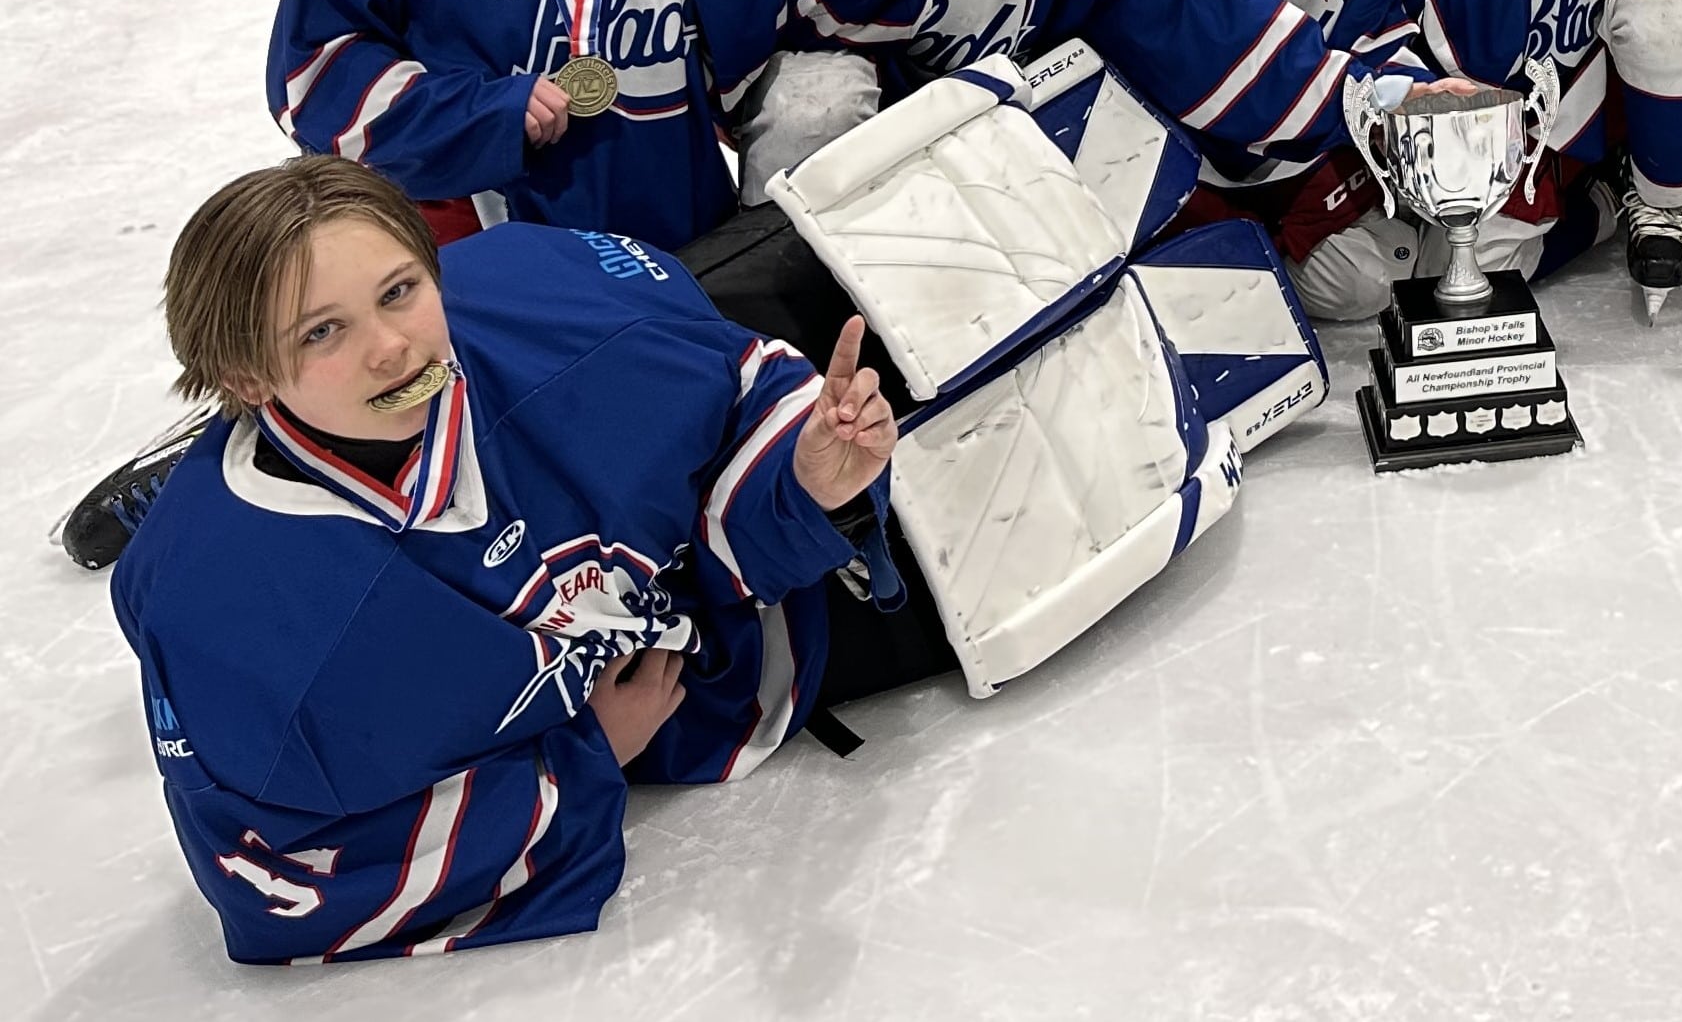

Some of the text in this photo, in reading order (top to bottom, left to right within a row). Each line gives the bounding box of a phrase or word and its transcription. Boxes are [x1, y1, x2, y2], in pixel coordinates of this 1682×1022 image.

[1028, 54, 1075, 89] EFLEX
[1456, 320, 1525, 336] Bishop's Falls
[1457, 332, 1525, 347] Minor Hockey
[1406, 360, 1546, 384] All Newfoundland Provincial
[1422, 373, 1532, 393] Championship Trophy
[1261, 380, 1314, 427] EFLEX
[560, 567, 609, 603] EARL
